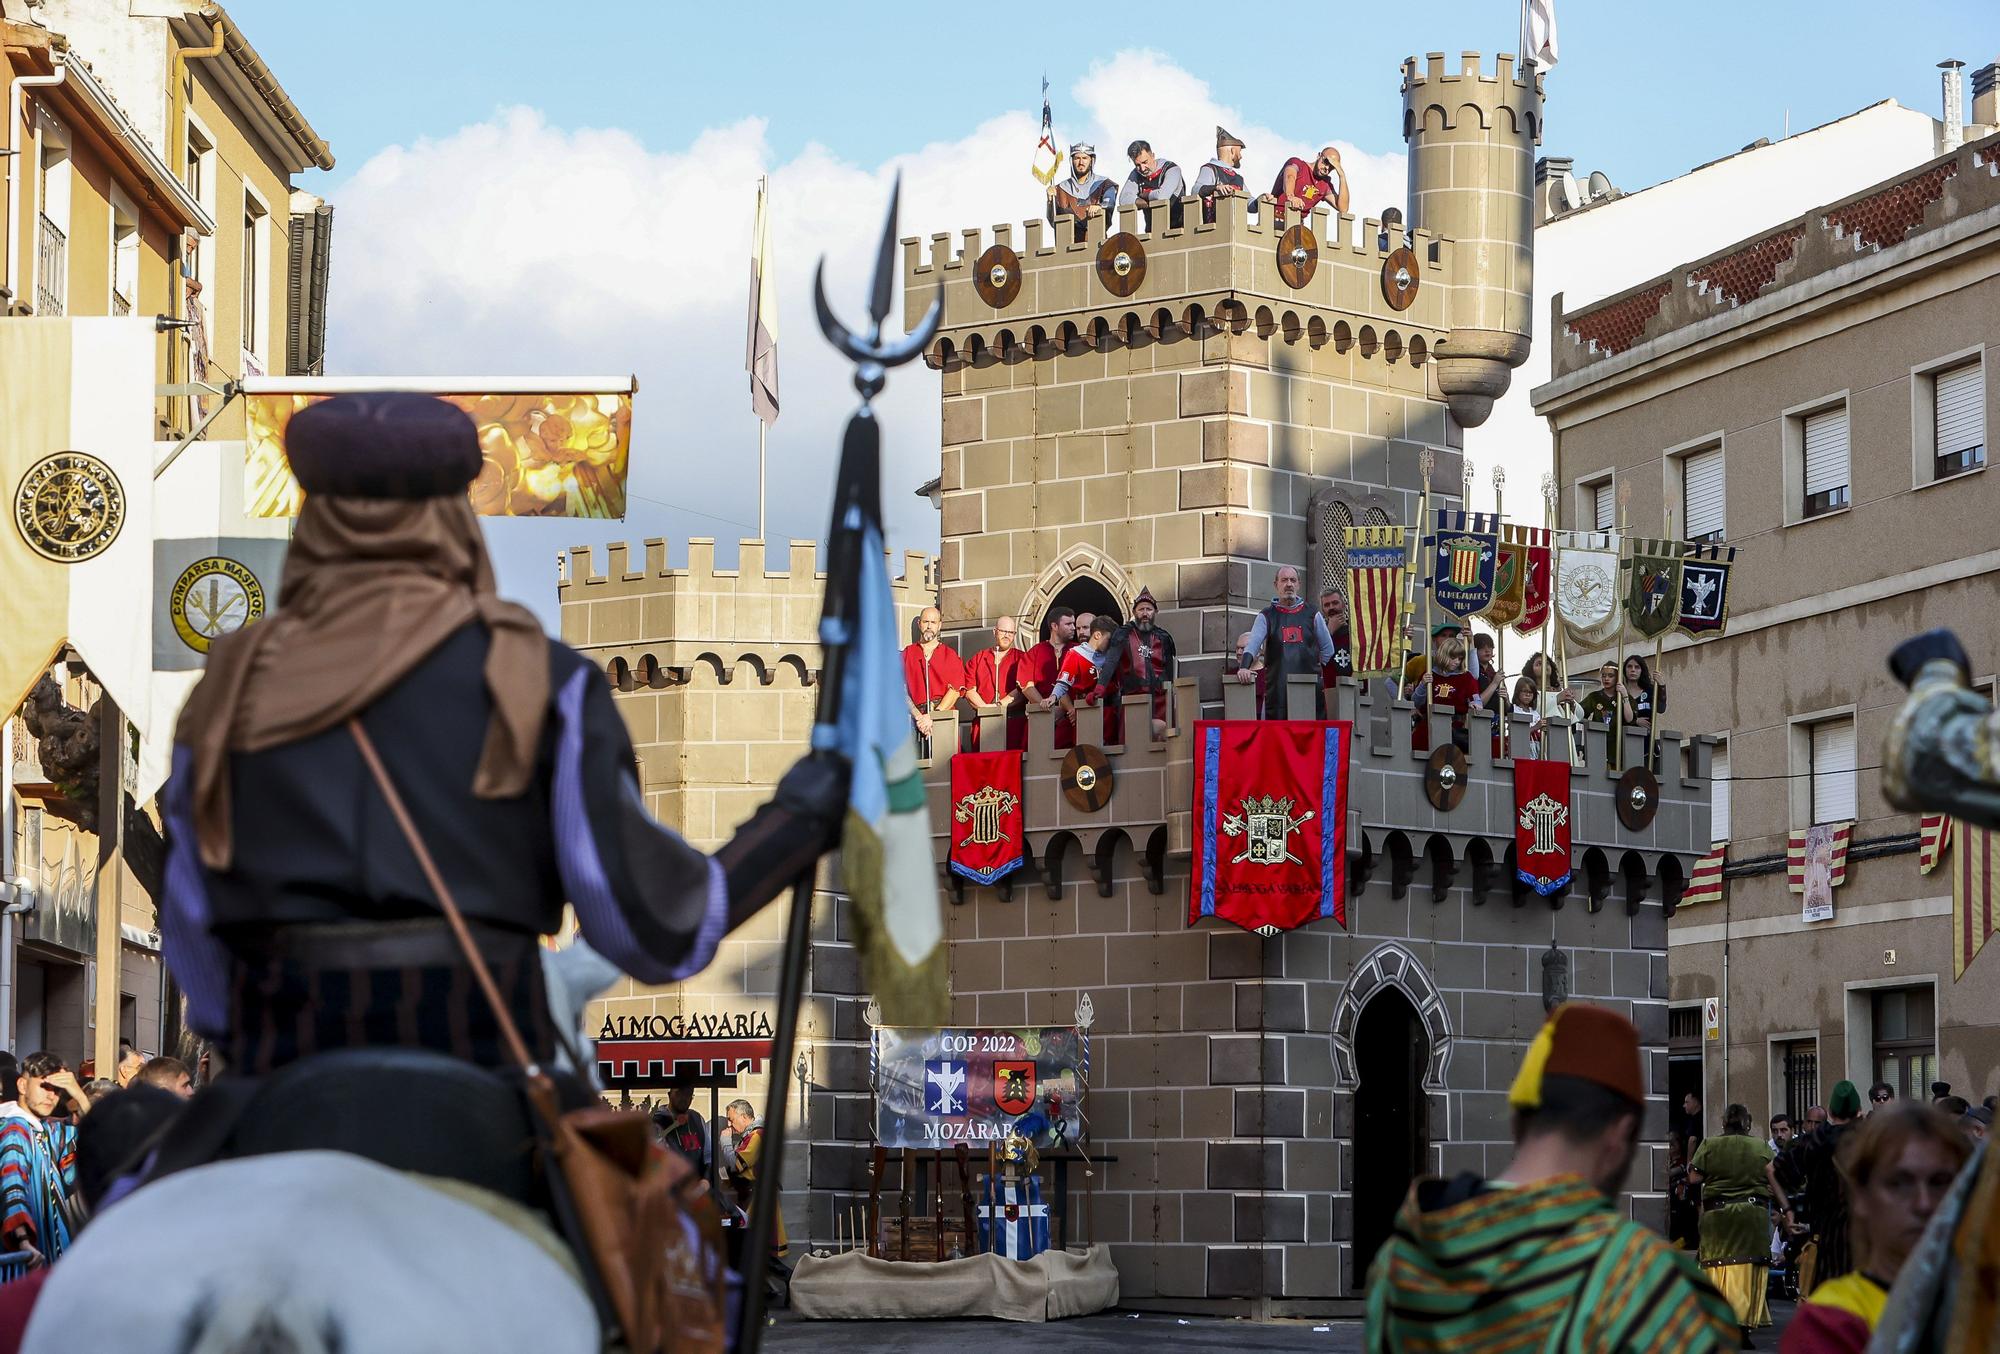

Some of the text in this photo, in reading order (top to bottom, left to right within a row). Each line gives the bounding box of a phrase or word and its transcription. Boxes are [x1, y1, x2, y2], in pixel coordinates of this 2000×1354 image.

[173, 561, 262, 618] COMPARSA MASEROS
[941, 1036, 1016, 1052] COP 2022
[923, 1119, 1013, 1140] MOZÁRAB
